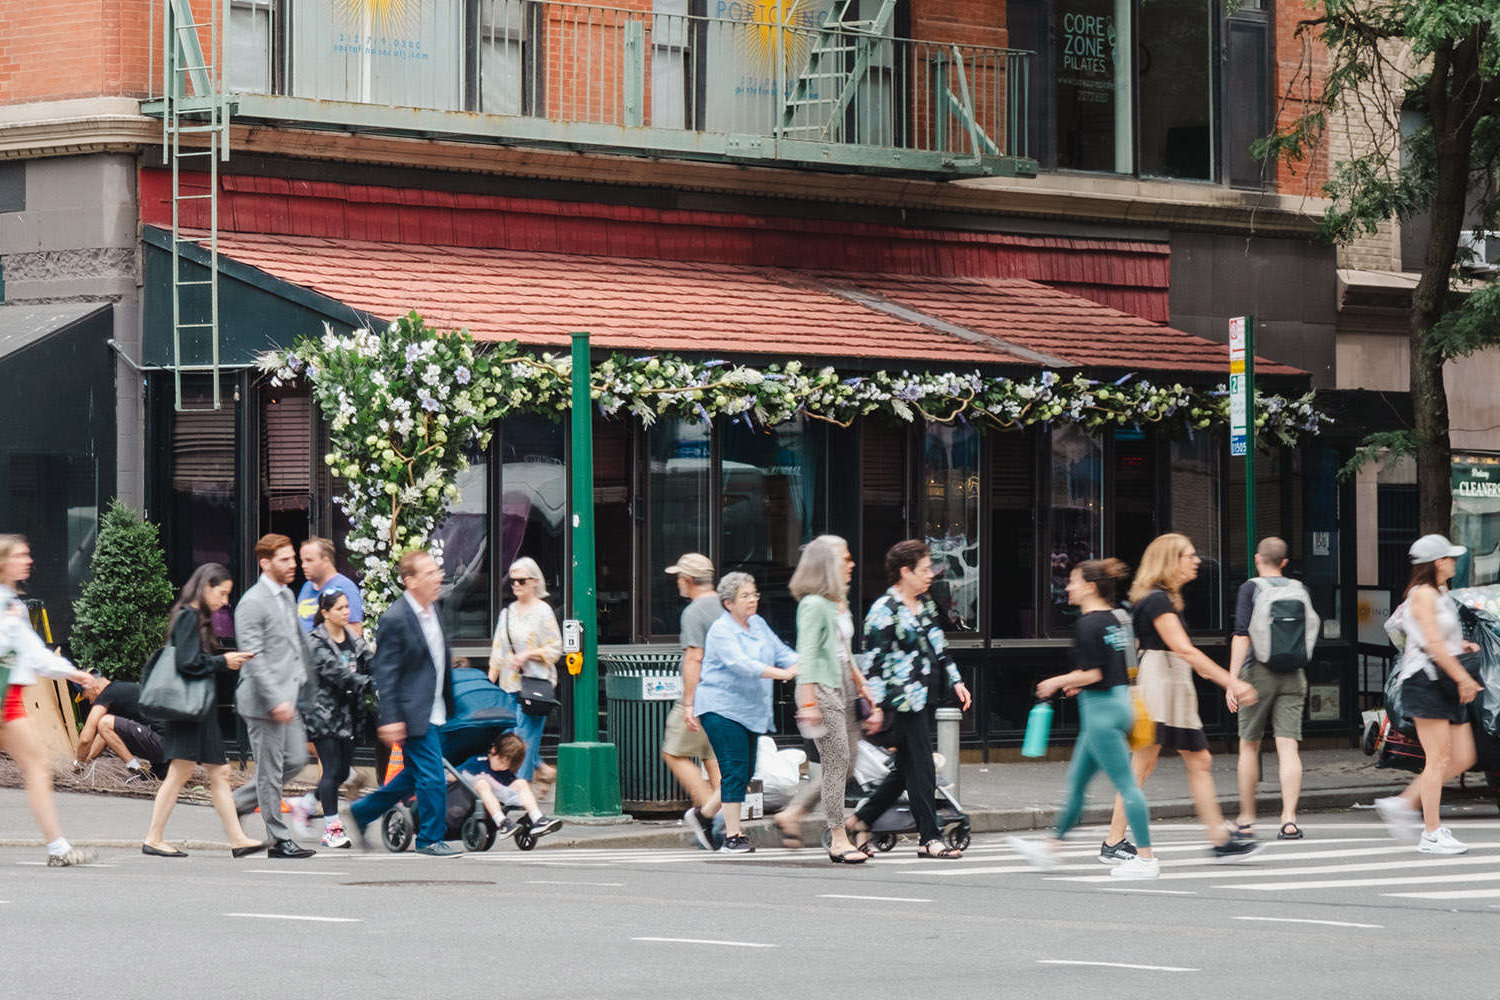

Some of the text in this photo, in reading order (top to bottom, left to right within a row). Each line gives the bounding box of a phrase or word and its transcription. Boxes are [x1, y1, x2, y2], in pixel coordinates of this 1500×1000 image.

[1064, 13, 1105, 36] CORE
[1064, 34, 1105, 58] ZONE
[1064, 55, 1106, 73] PILATES
